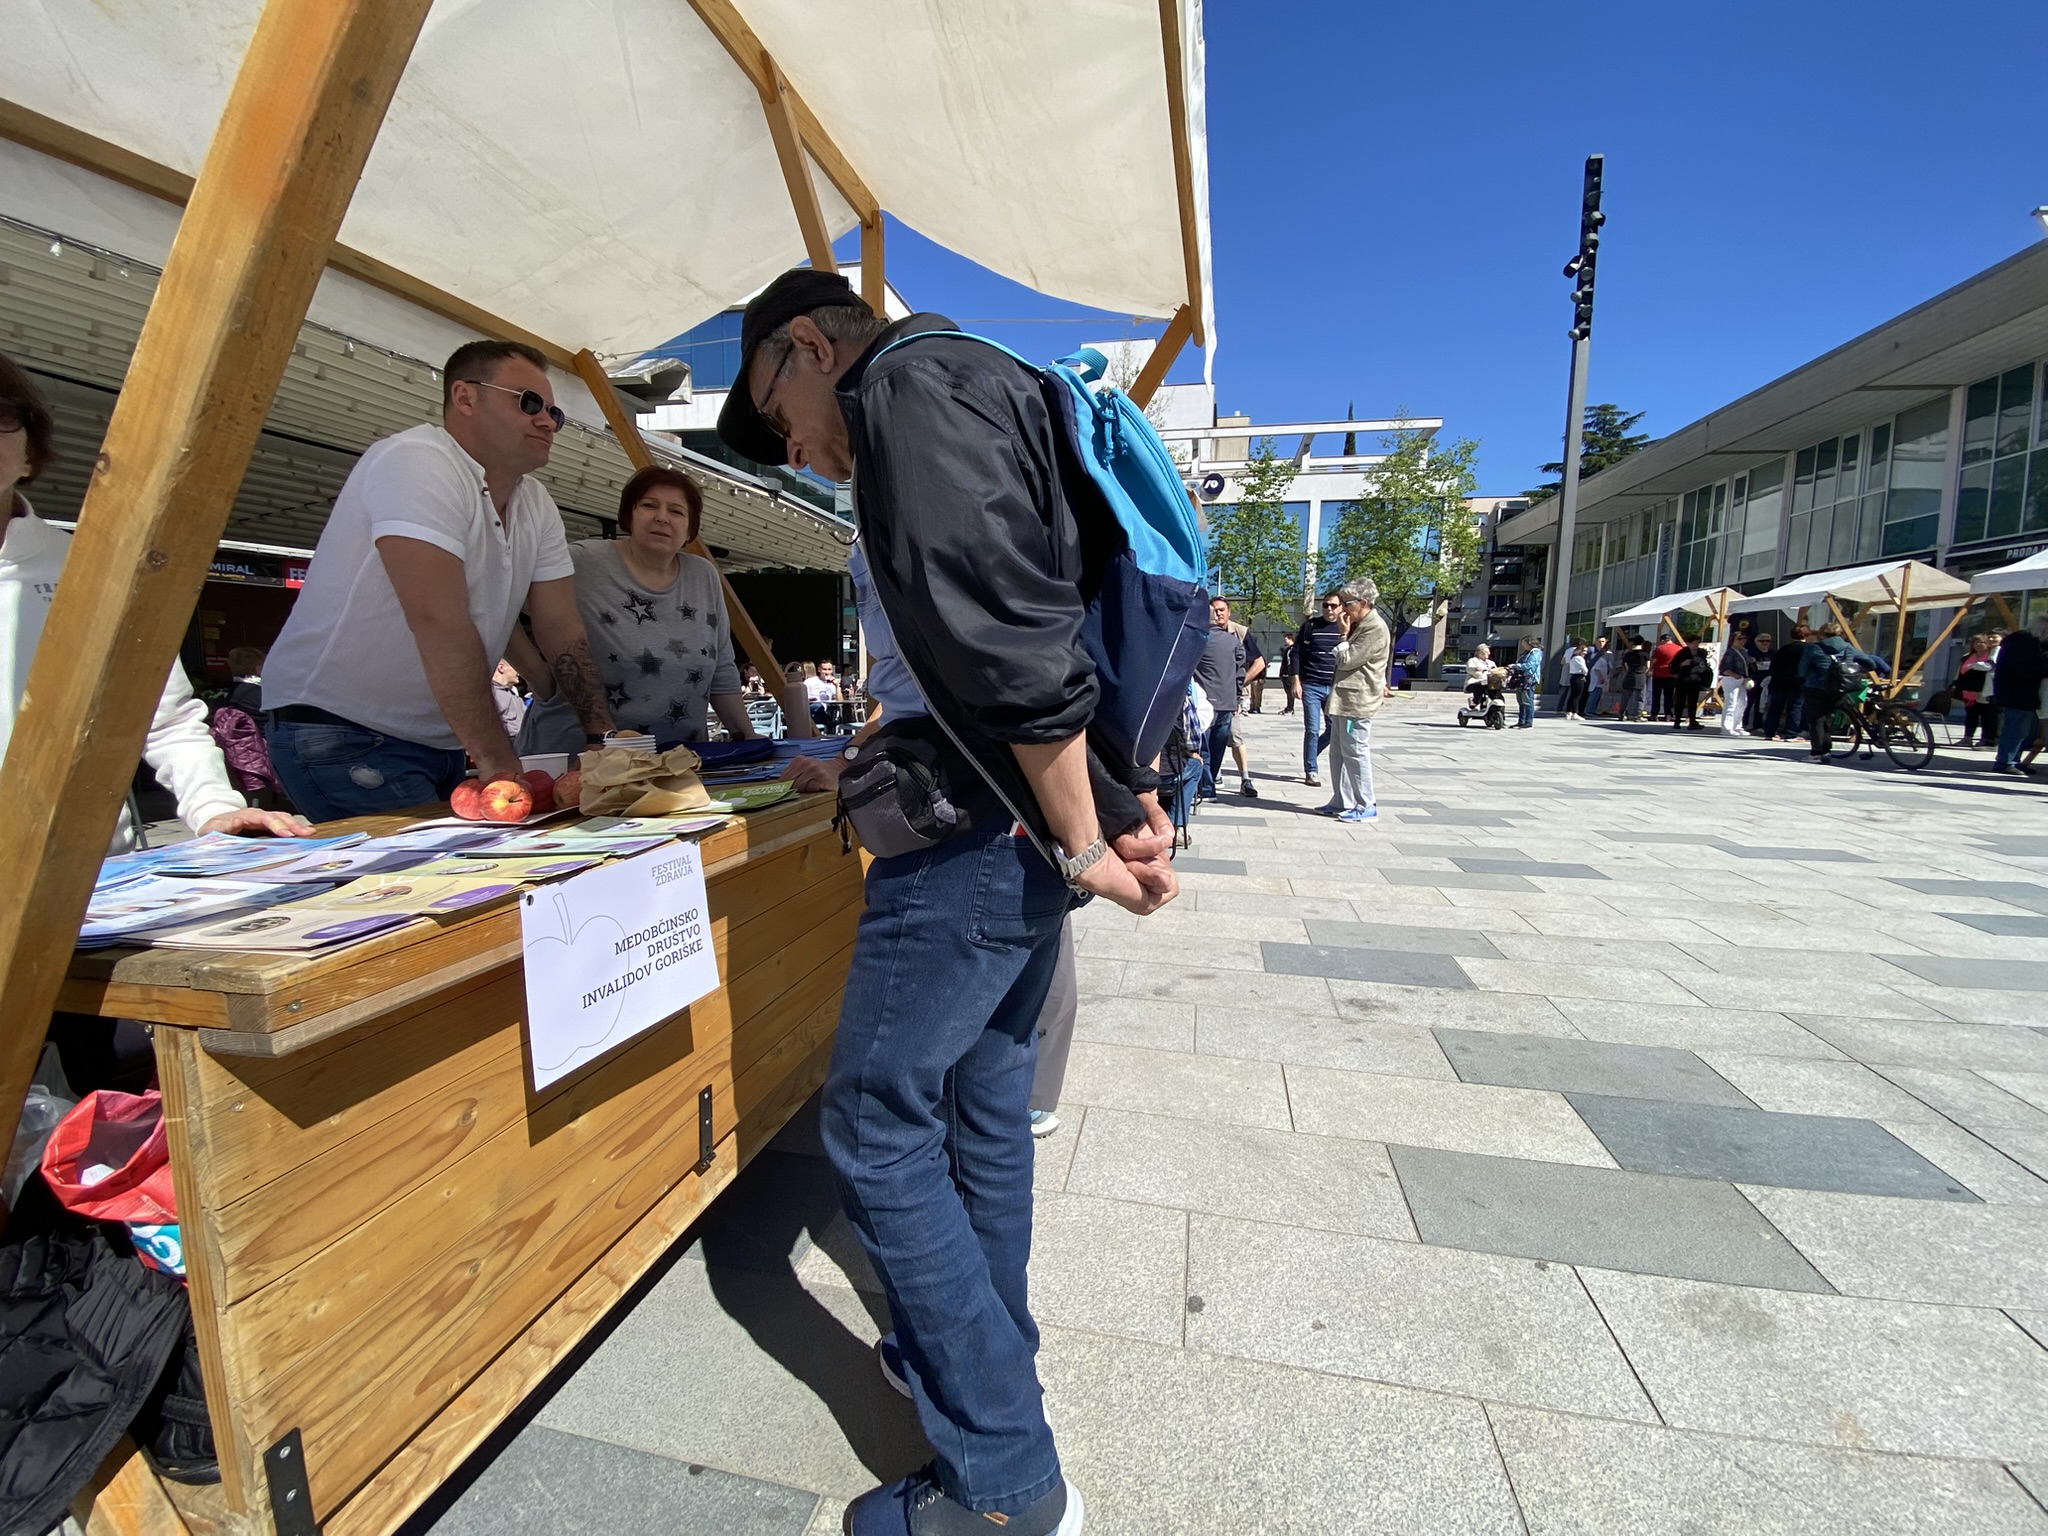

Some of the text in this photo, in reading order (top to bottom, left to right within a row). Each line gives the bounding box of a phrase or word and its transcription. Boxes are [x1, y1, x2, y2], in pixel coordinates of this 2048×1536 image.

[289, 567, 308, 582] FE
[652, 855, 692, 877] FESTIVAL
[655, 865, 693, 886] ZDRAVJA
[614, 907, 699, 955] MEDOBČINSKO
[647, 923, 701, 958] DRUŠTVO
[582, 938, 703, 1009] INVALIDOV GORIŠKE
